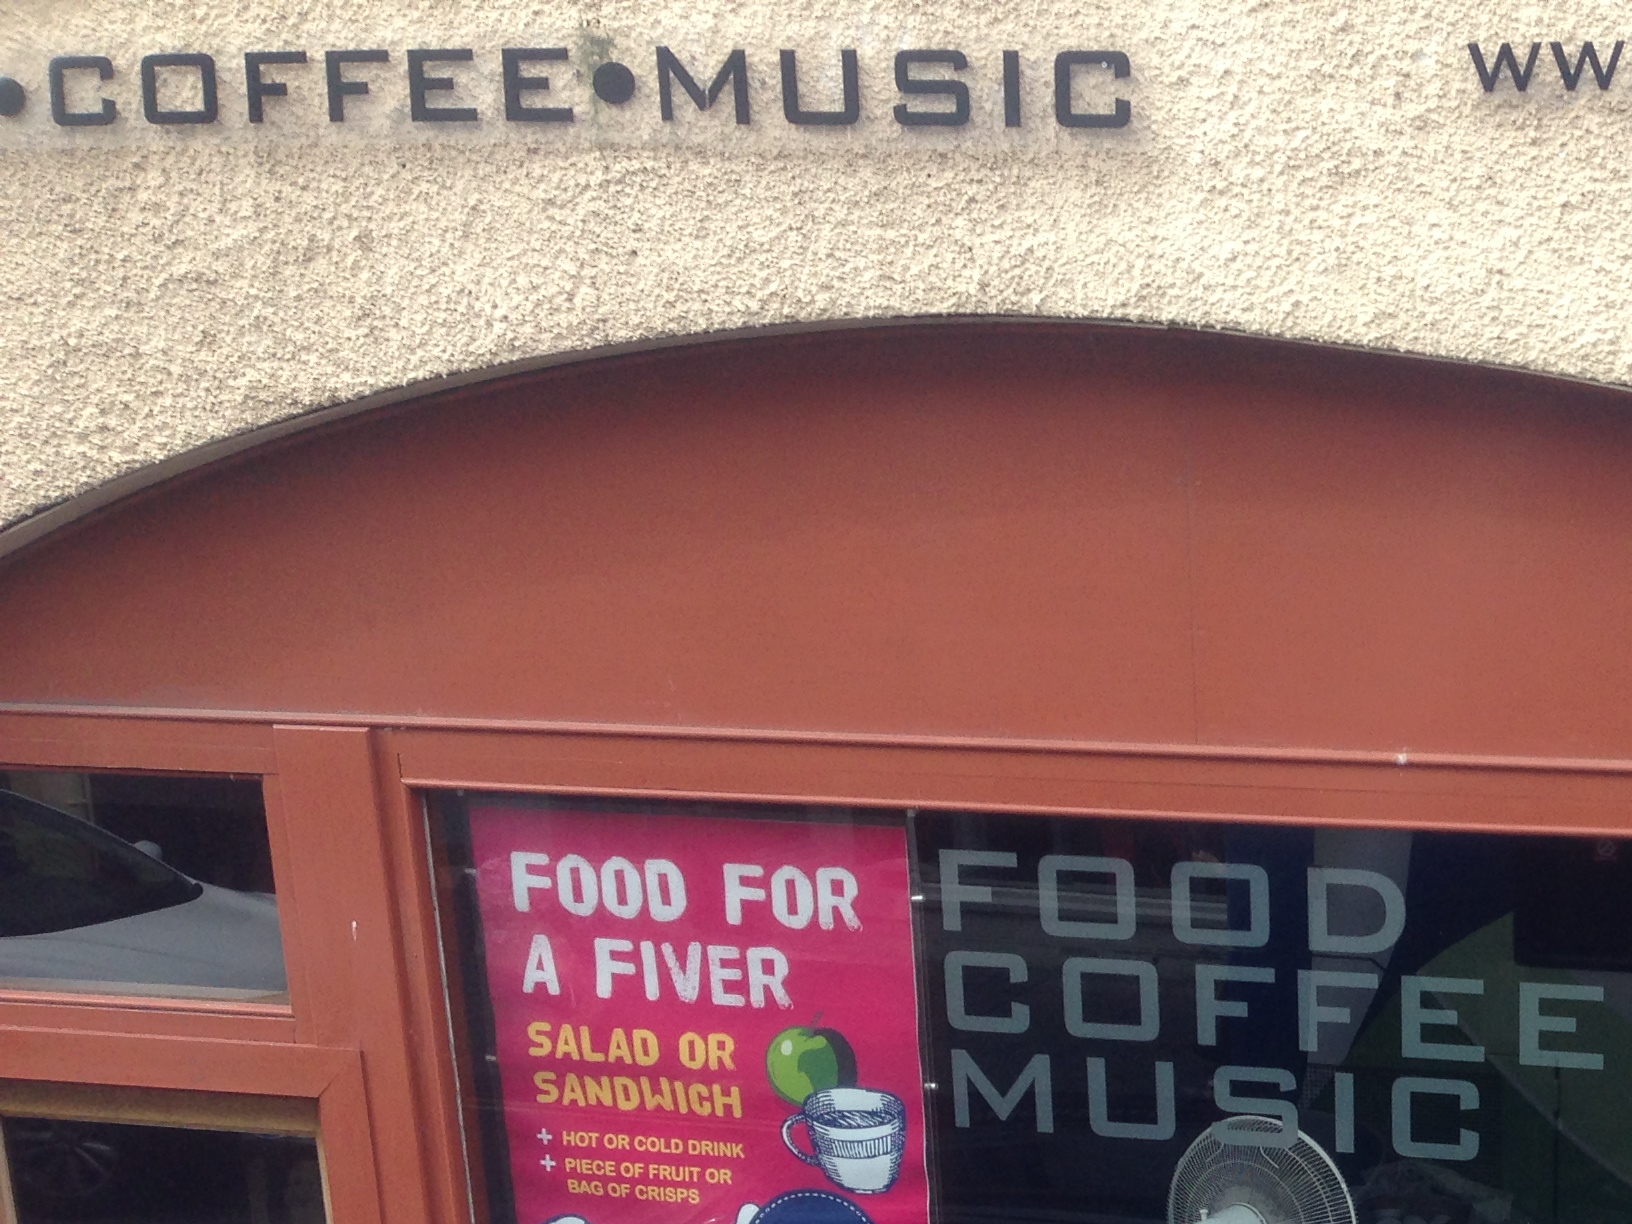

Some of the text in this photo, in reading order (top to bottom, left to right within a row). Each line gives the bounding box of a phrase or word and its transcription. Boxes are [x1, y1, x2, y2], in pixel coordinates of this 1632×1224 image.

[509, 850, 864, 932] FOOD FOR
[938, 848, 1407, 955] FOOD
[521, 933, 794, 1010] A FIVER
[944, 949, 1606, 1071] COFFEE
[526, 1020, 738, 1073] SALAD OR
[533, 1070, 744, 1119] SANDWICH
[950, 1048, 1481, 1162] MUSIC
[561, 1129, 601, 1149] HOT
[602, 1132, 631, 1151] OR
[633, 1135, 685, 1155] COLD
[687, 1138, 746, 1160] DRINK
[564, 1157, 617, 1178] PIECE
[619, 1161, 646, 1179] OF
[648, 1163, 702, 1183] FRUIT
[704, 1167, 733, 1186] OR
[566, 1178, 701, 1205] BAG OF CRISPS
